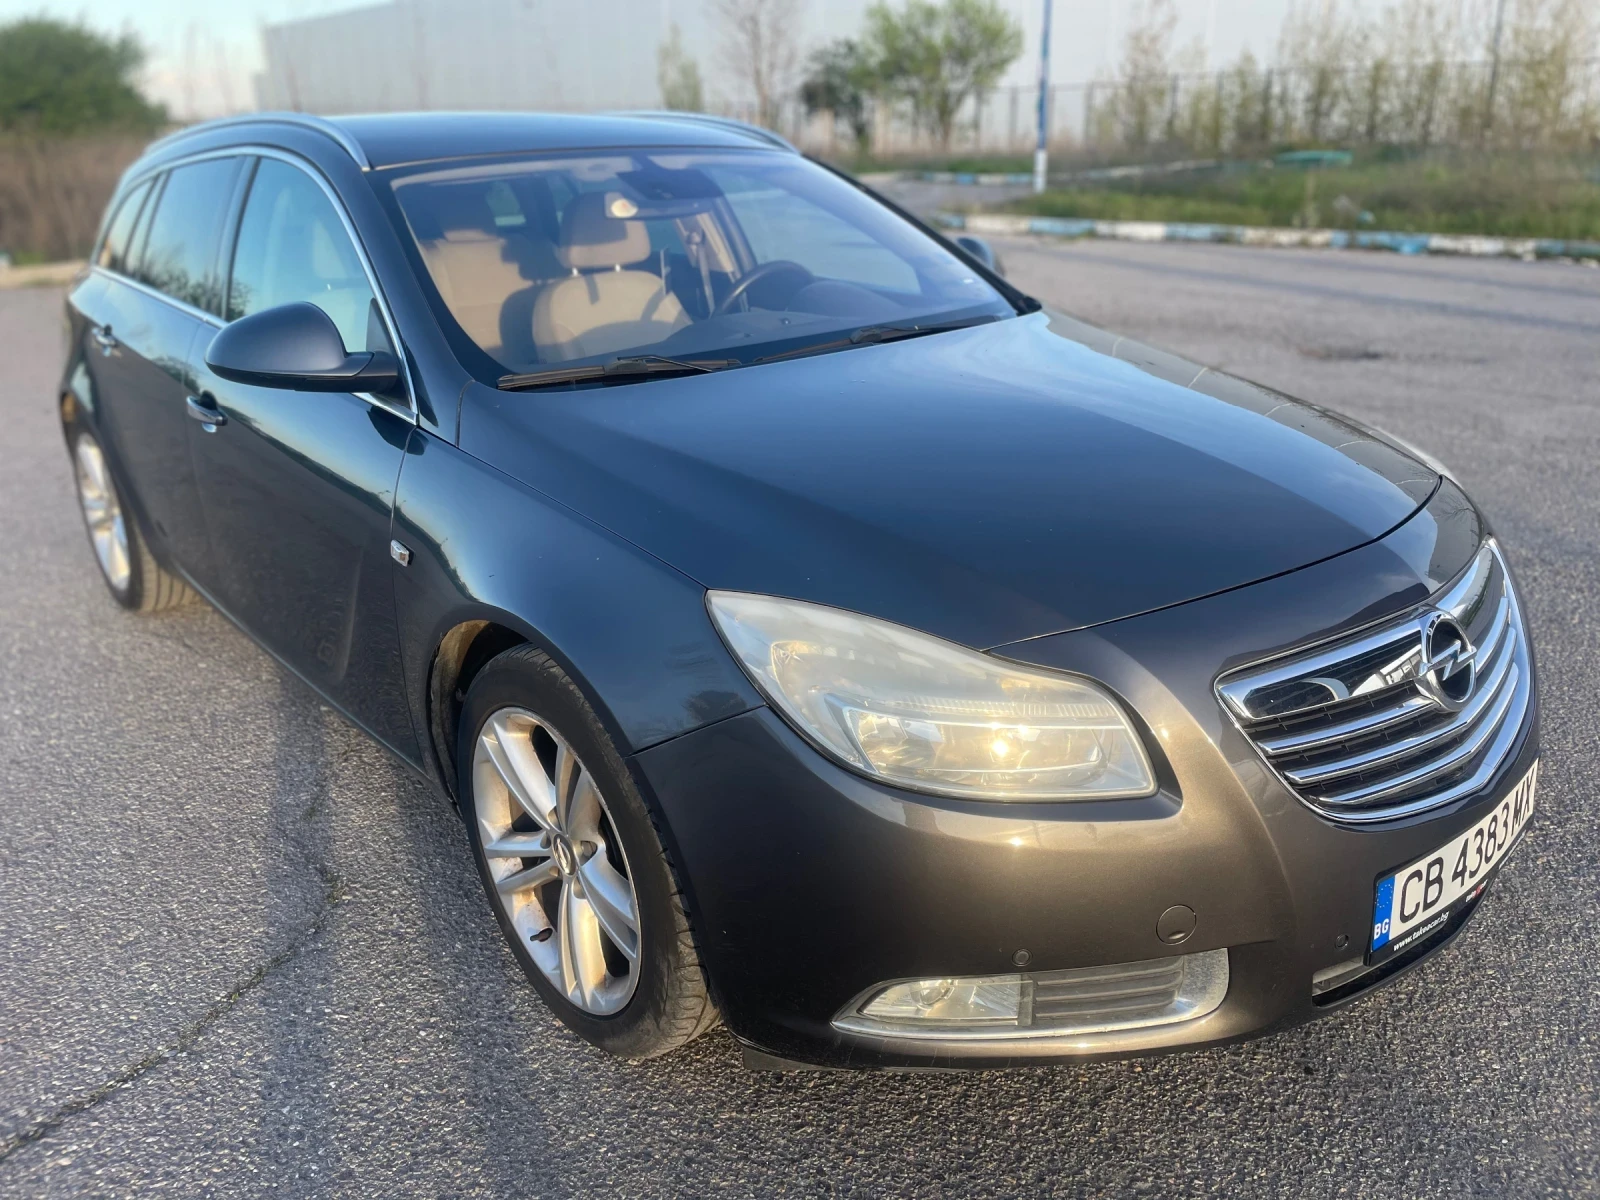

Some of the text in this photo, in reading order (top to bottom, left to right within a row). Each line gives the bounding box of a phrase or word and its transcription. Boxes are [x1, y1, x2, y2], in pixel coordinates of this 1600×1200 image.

[1399, 856, 1444, 924] CB
[1451, 801, 1510, 888] 4383
[1511, 766, 1535, 837] MX
[1374, 918, 1390, 940] BG
